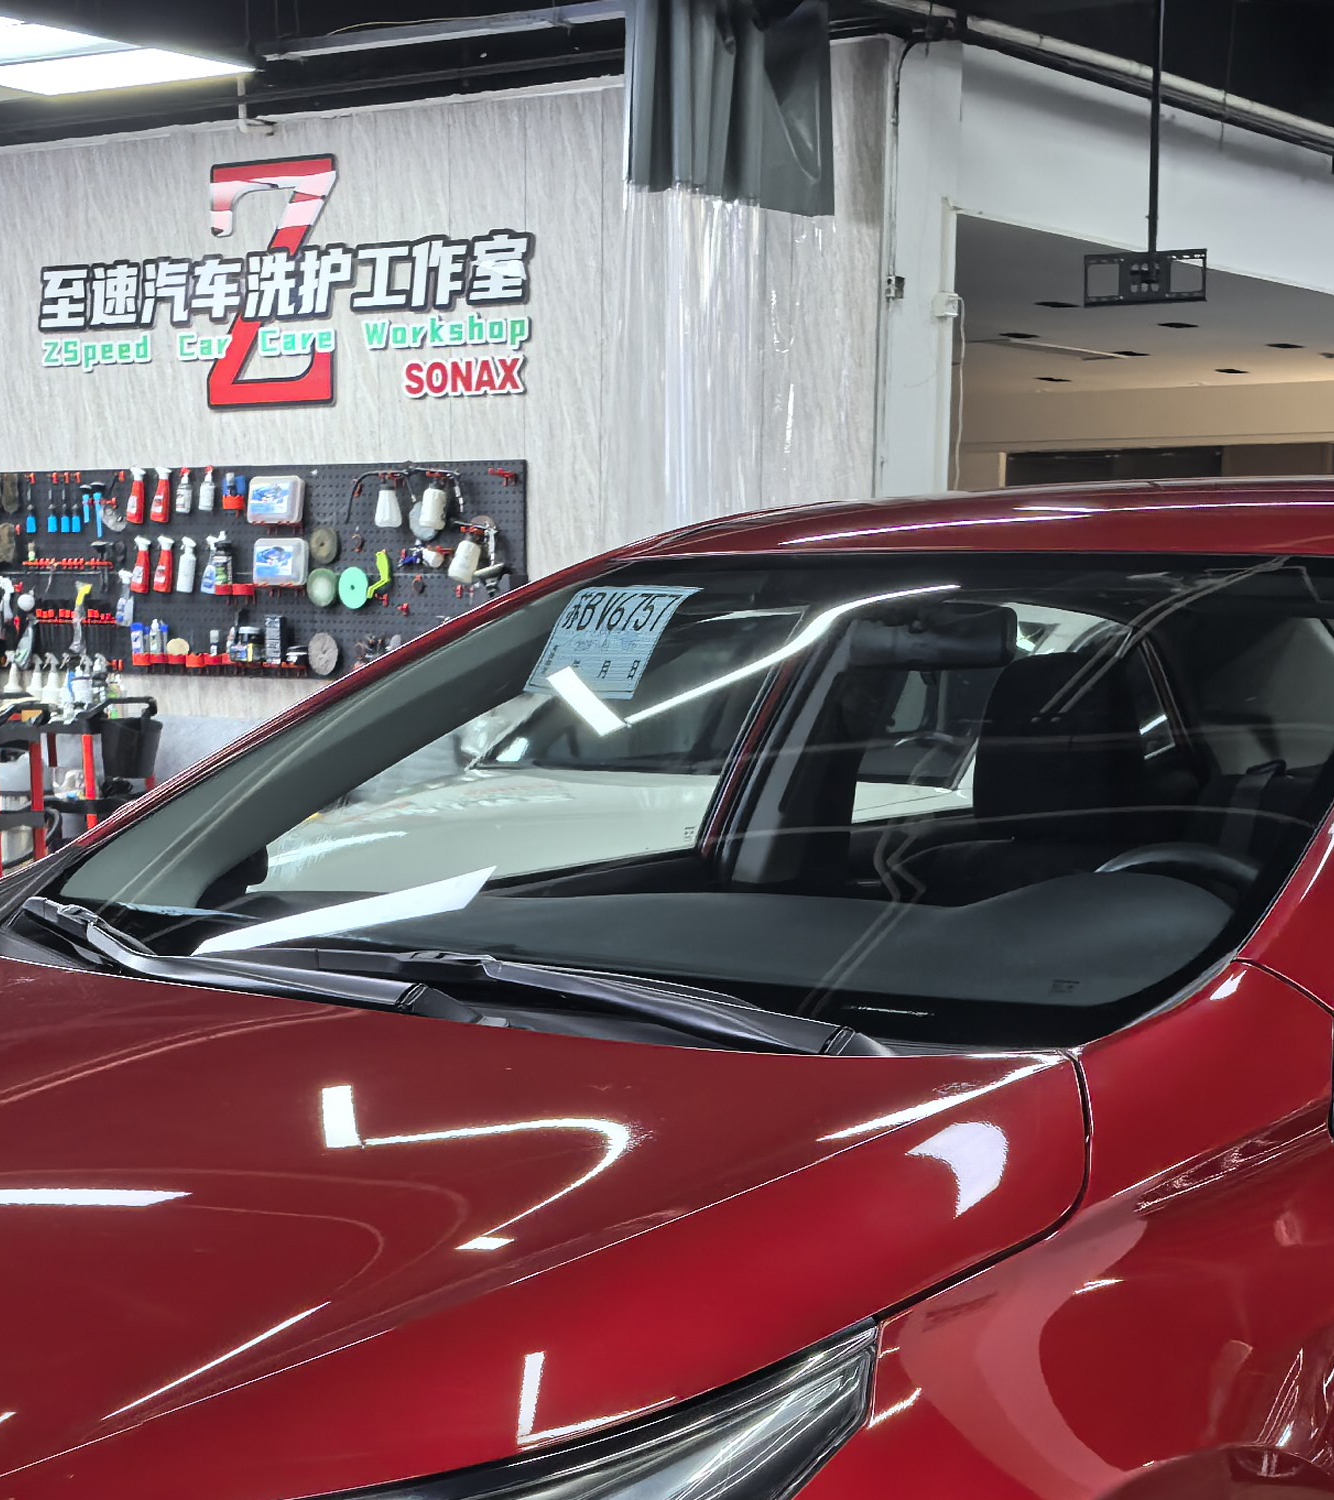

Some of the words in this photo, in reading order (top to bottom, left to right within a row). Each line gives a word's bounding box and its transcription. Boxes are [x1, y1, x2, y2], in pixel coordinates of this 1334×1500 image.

[41, 231, 533, 331] 至速汽车洗护工作室
[178, 333, 231, 362] Car
[258, 326, 335, 356] Care
[364, 314, 530, 351] Workshop
[405, 358, 525, 397] SONAX
